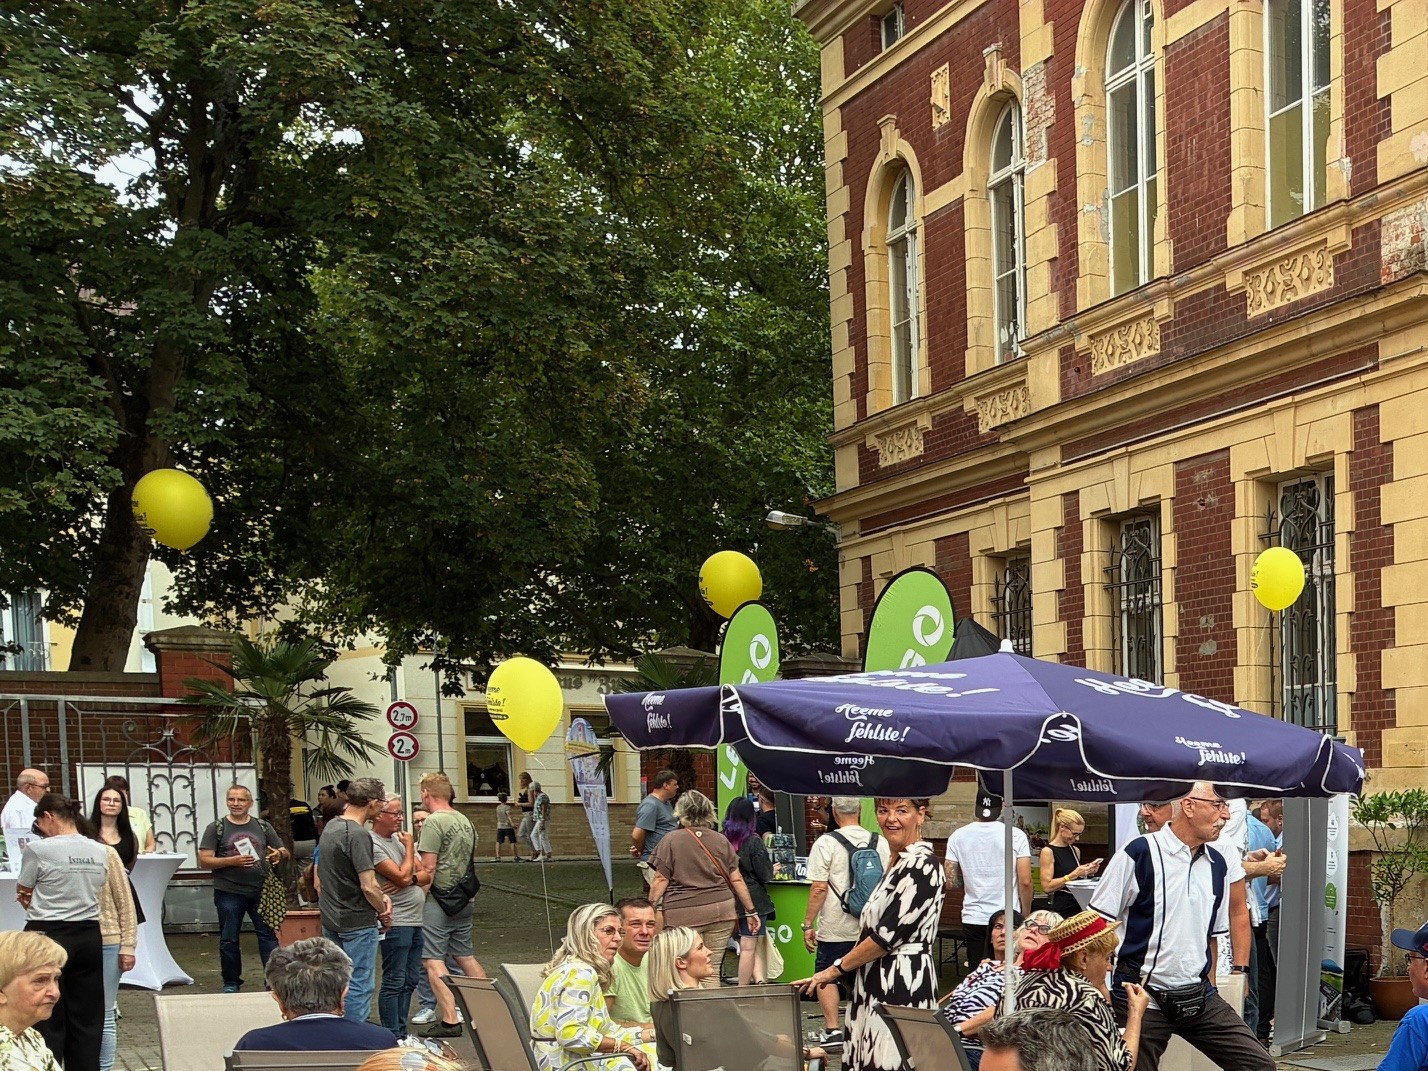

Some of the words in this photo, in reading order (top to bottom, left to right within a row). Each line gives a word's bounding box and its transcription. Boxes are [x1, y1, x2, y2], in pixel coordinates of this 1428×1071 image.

[834, 703, 894, 720] Heeme
[844, 721, 911, 743] fehlste!
[1197, 749, 1246, 766] fehlste!
